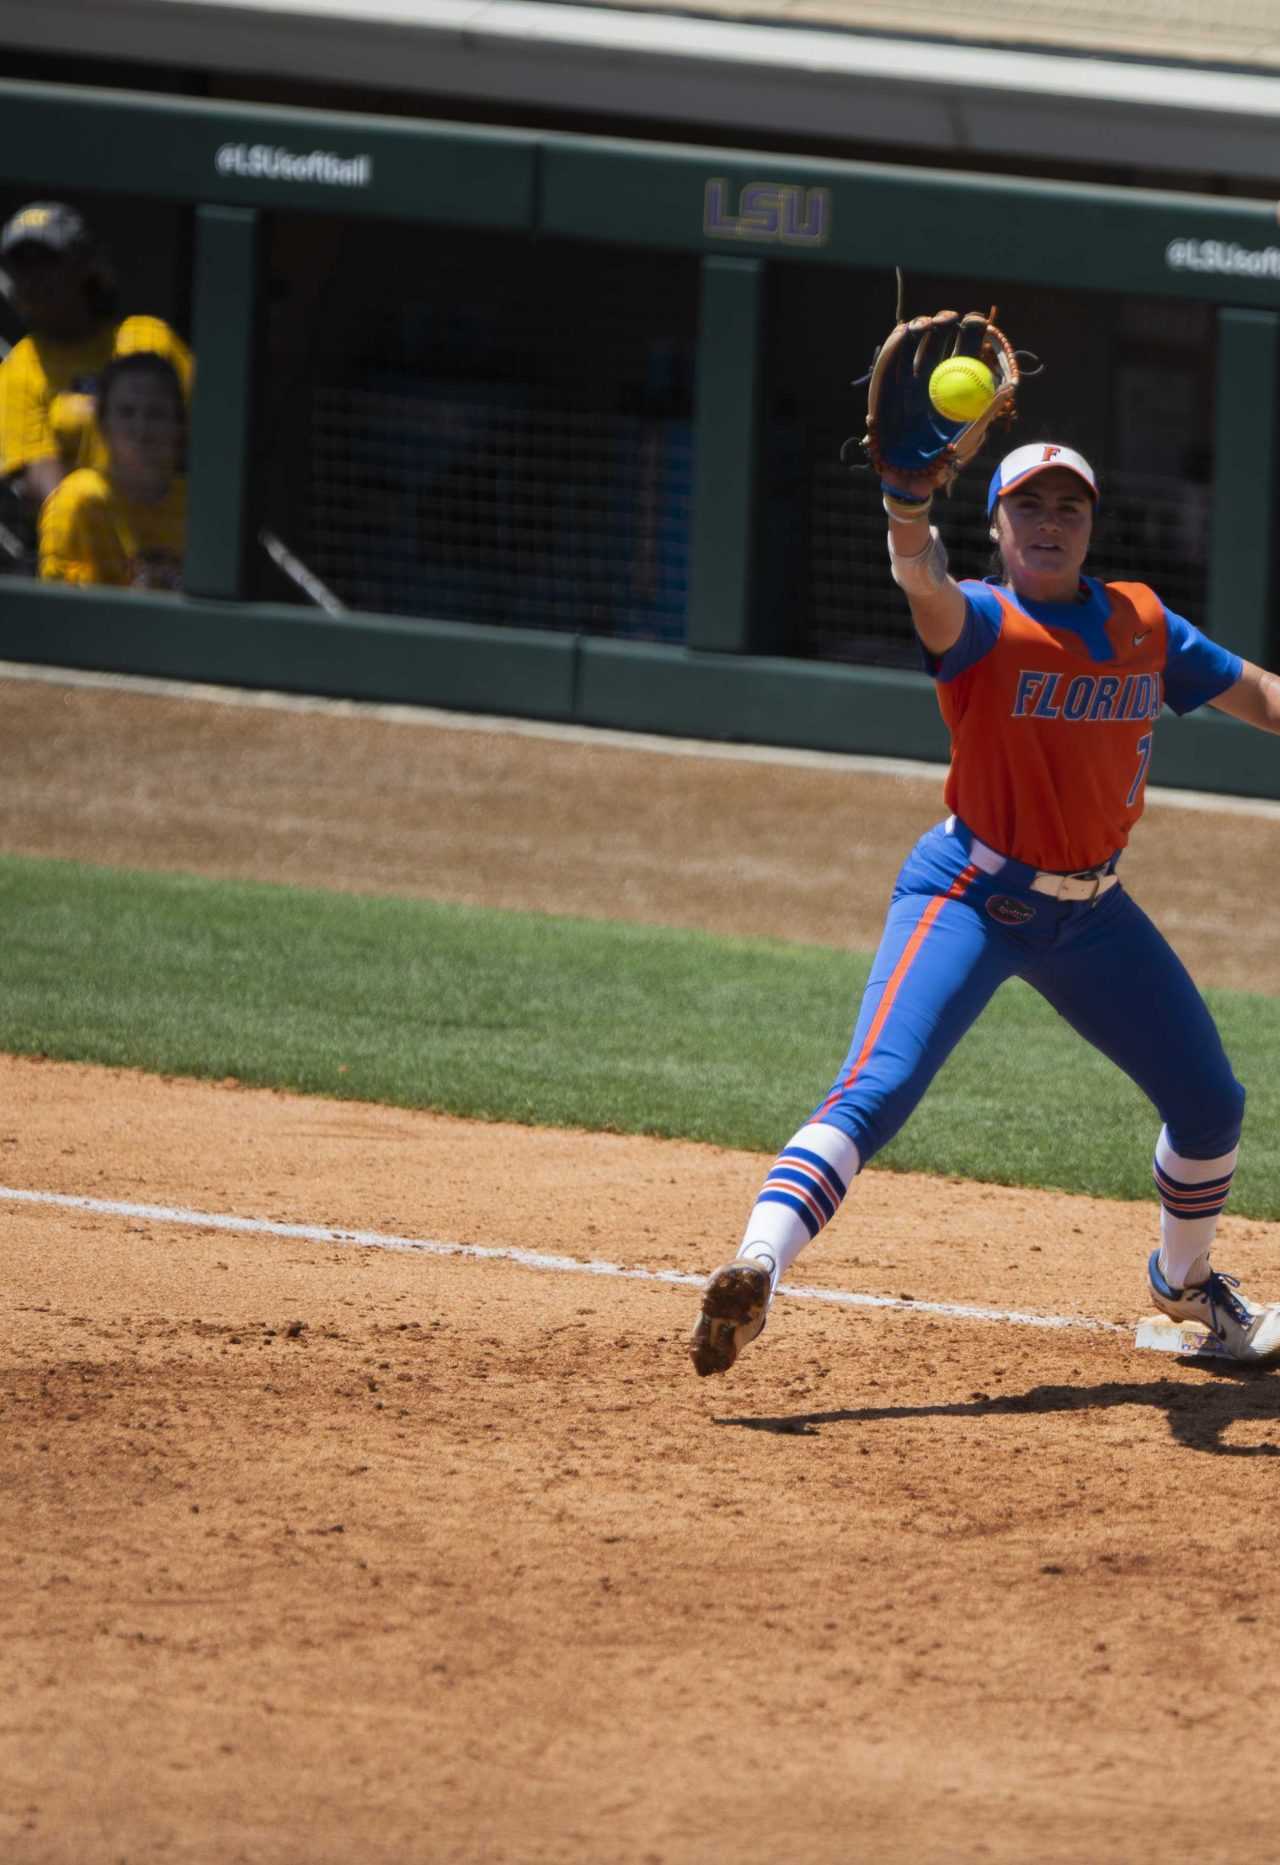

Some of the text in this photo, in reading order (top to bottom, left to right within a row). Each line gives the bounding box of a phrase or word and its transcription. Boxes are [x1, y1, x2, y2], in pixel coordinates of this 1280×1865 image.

[215, 143, 372, 187] @LSUsoftball
[703, 177, 833, 248] LSU
[1041, 446, 1062, 462] F
